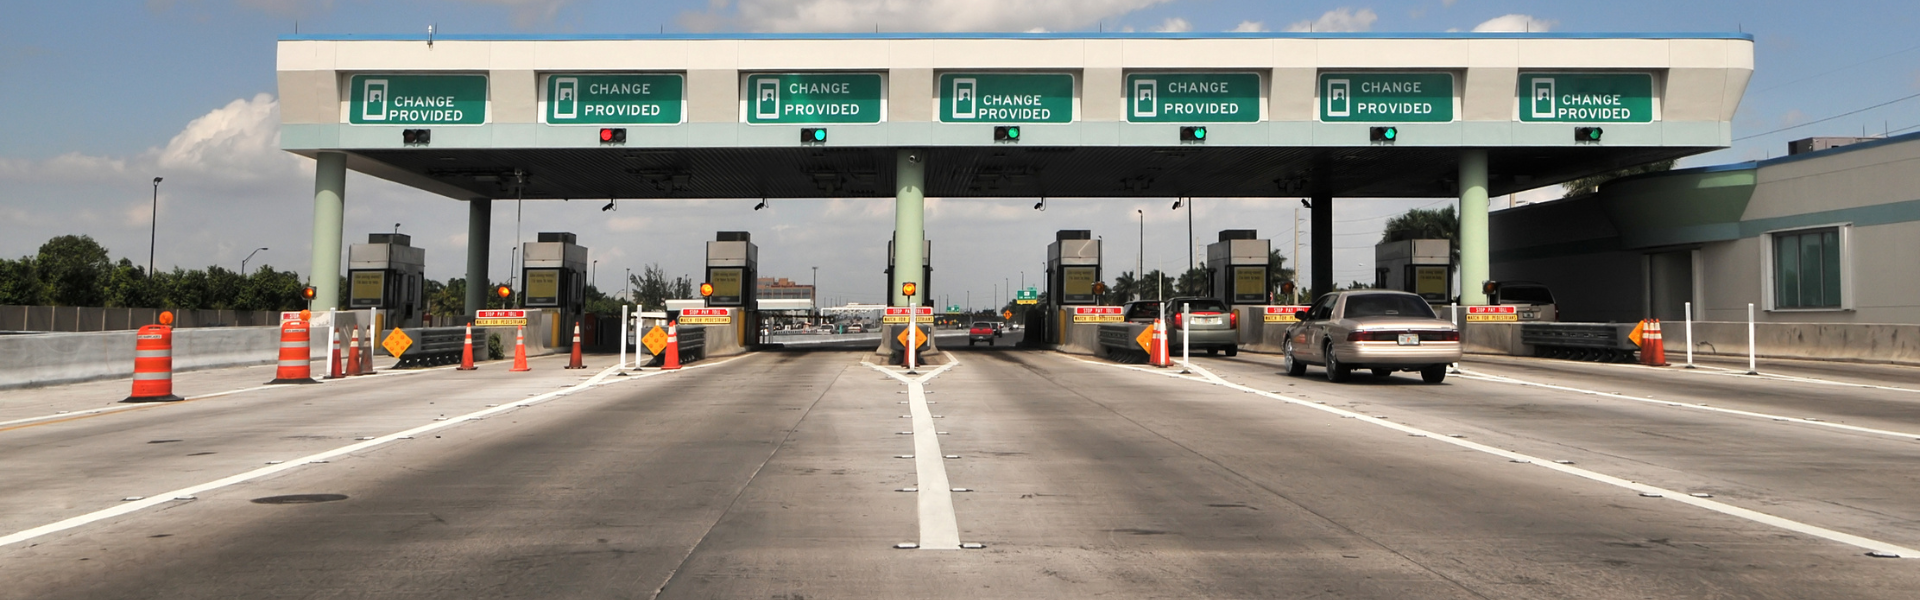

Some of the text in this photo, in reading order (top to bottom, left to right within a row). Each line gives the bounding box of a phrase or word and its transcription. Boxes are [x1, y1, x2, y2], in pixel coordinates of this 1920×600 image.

[590, 84, 650, 94] CHANGE
[789, 84, 849, 94] CHANGE
[1169, 83, 1228, 93] CHANGE
[1361, 83, 1421, 92] CHANGE
[395, 97, 454, 107] CHANGE
[984, 95, 1041, 105] CHANGE
[1562, 95, 1620, 105] CHANGE
[585, 105, 660, 115] PROVIDED
[785, 104, 860, 115] PROVIDED
[1165, 103, 1238, 113] PROVIDED
[1358, 103, 1431, 113] PROVIDED
[390, 110, 462, 121] PROVIDED
[979, 109, 1050, 119] PROVIDED
[1559, 108, 1630, 119] PROVIDED
